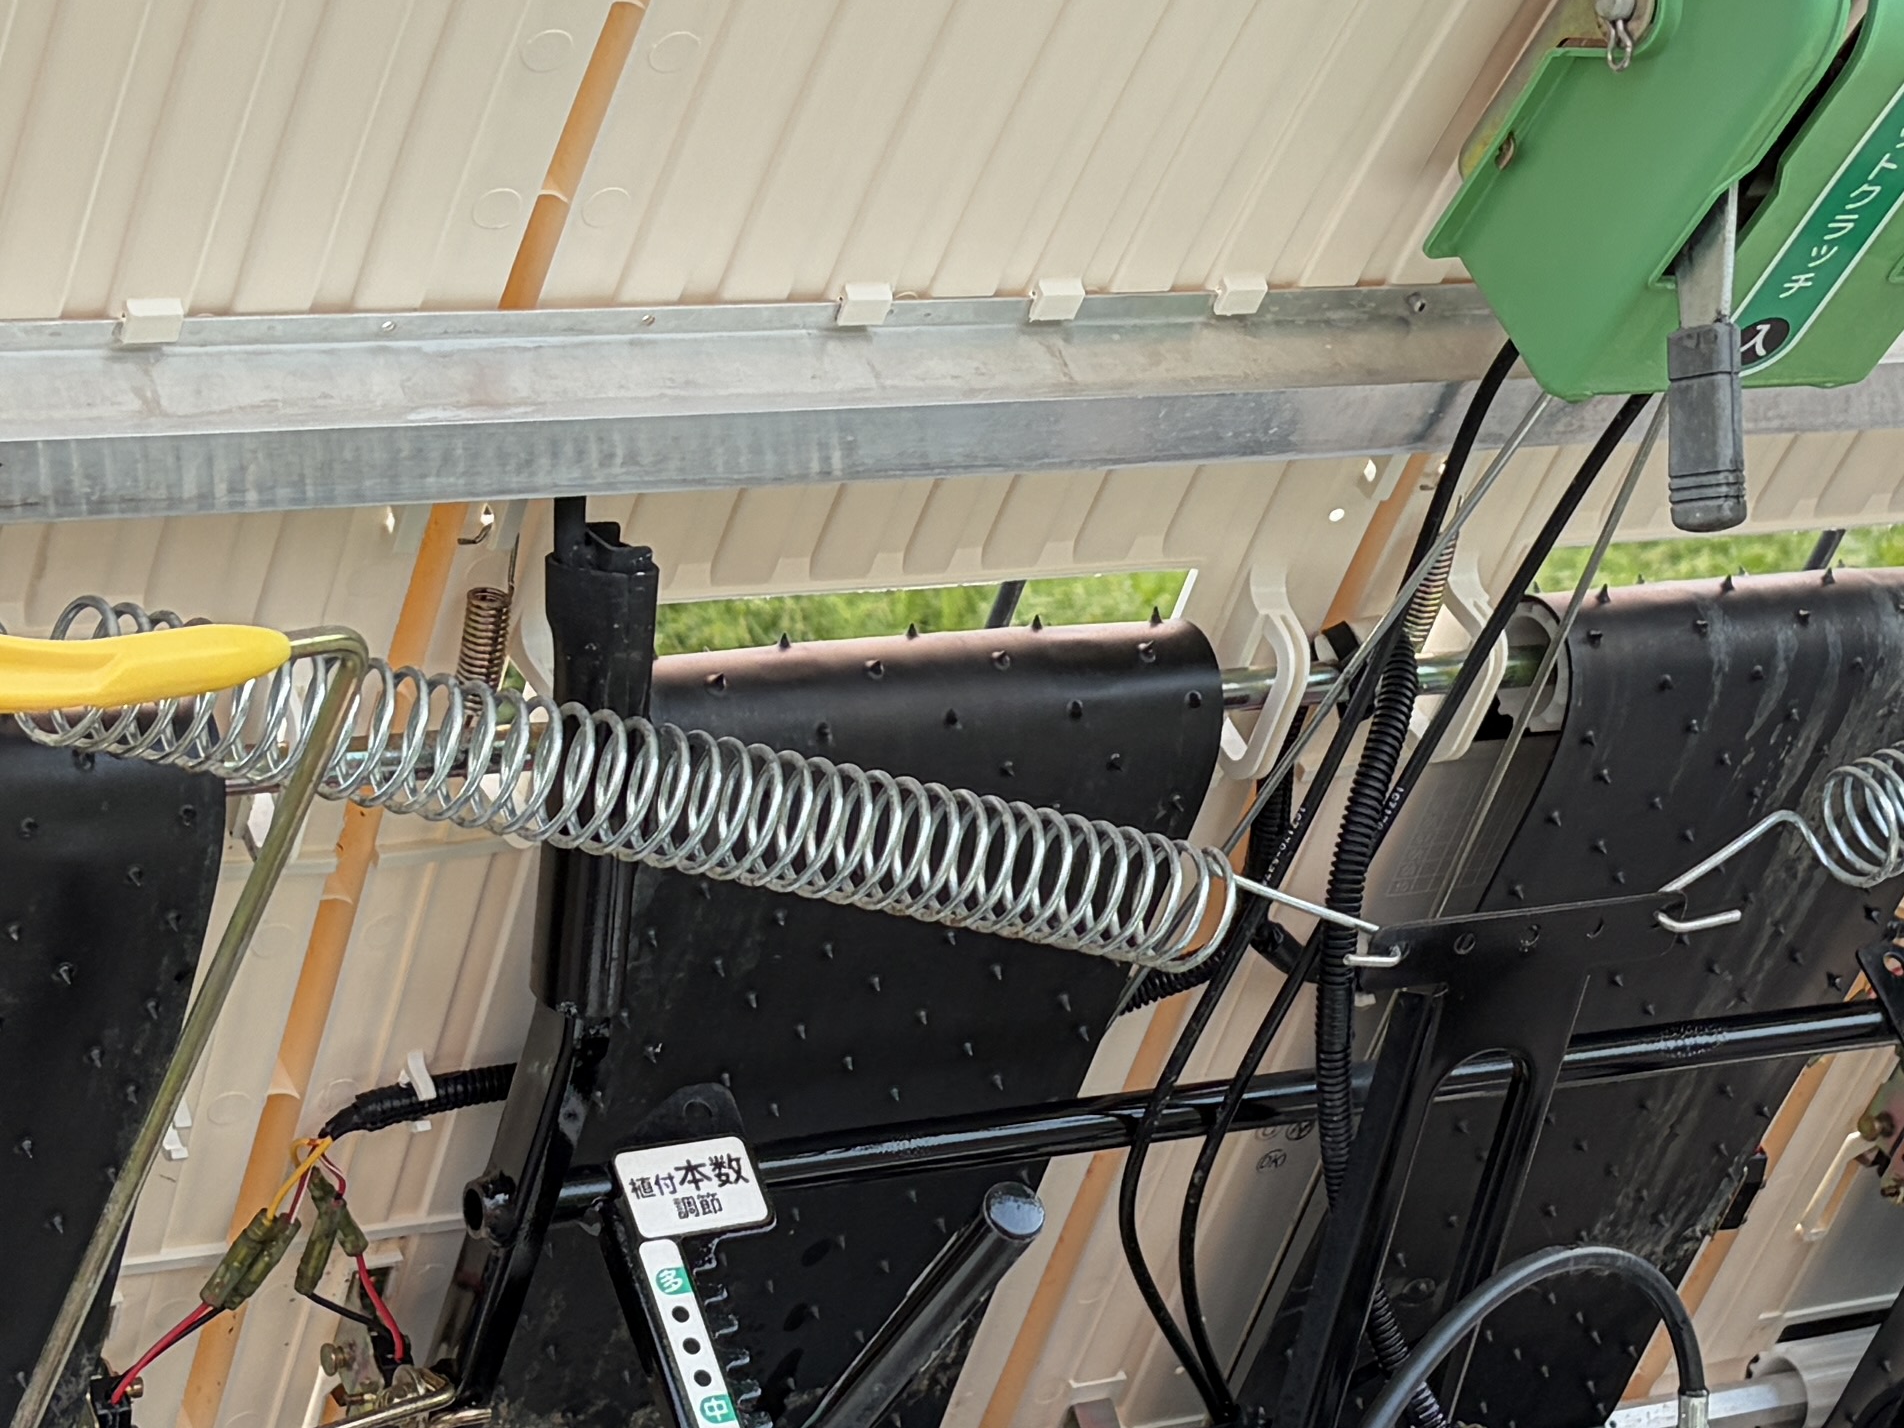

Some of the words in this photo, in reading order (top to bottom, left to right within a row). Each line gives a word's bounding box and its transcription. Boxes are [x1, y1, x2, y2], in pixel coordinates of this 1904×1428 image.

[628, 1152, 750, 1200] 植付本数
[673, 1192, 723, 1220] 調節
[658, 1267, 684, 1294] 多
[704, 1397, 728, 1422] 中
